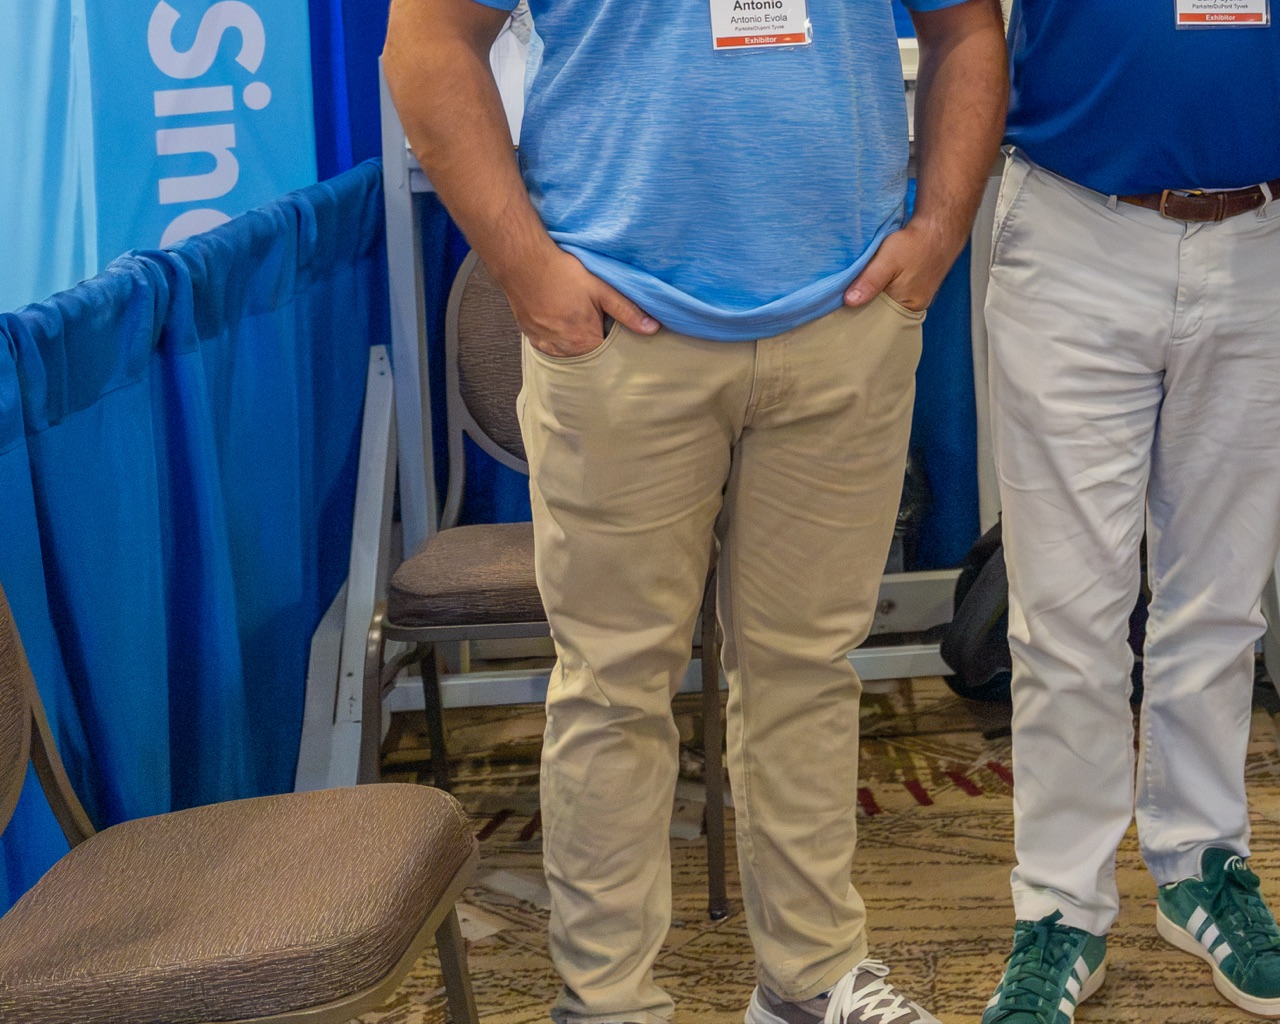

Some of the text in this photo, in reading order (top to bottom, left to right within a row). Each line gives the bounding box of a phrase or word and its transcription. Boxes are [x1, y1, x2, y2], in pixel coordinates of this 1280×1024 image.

[733, 0, 783, 11] Antonio
[731, 14, 788, 24] Antonio Evola
